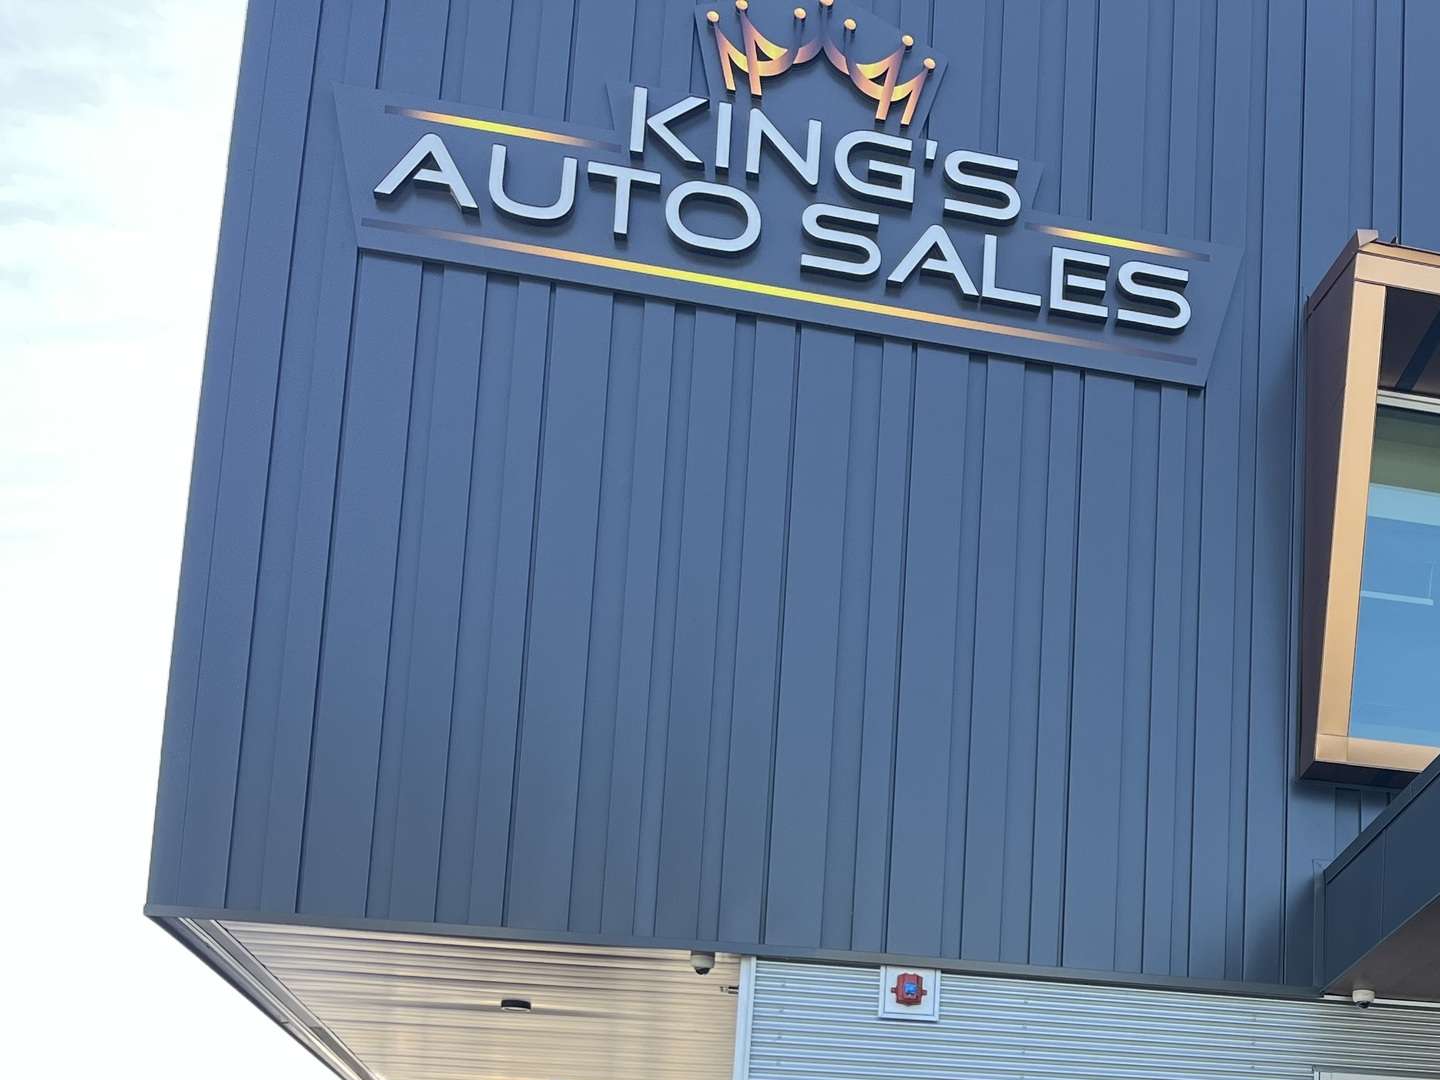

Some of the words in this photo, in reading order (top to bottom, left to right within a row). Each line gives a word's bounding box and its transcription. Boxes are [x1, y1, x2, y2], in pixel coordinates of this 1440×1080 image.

[374, 133, 763, 257] AUTO
[800, 203, 1193, 334] SALES
[629, 87, 1021, 221] KING'S
